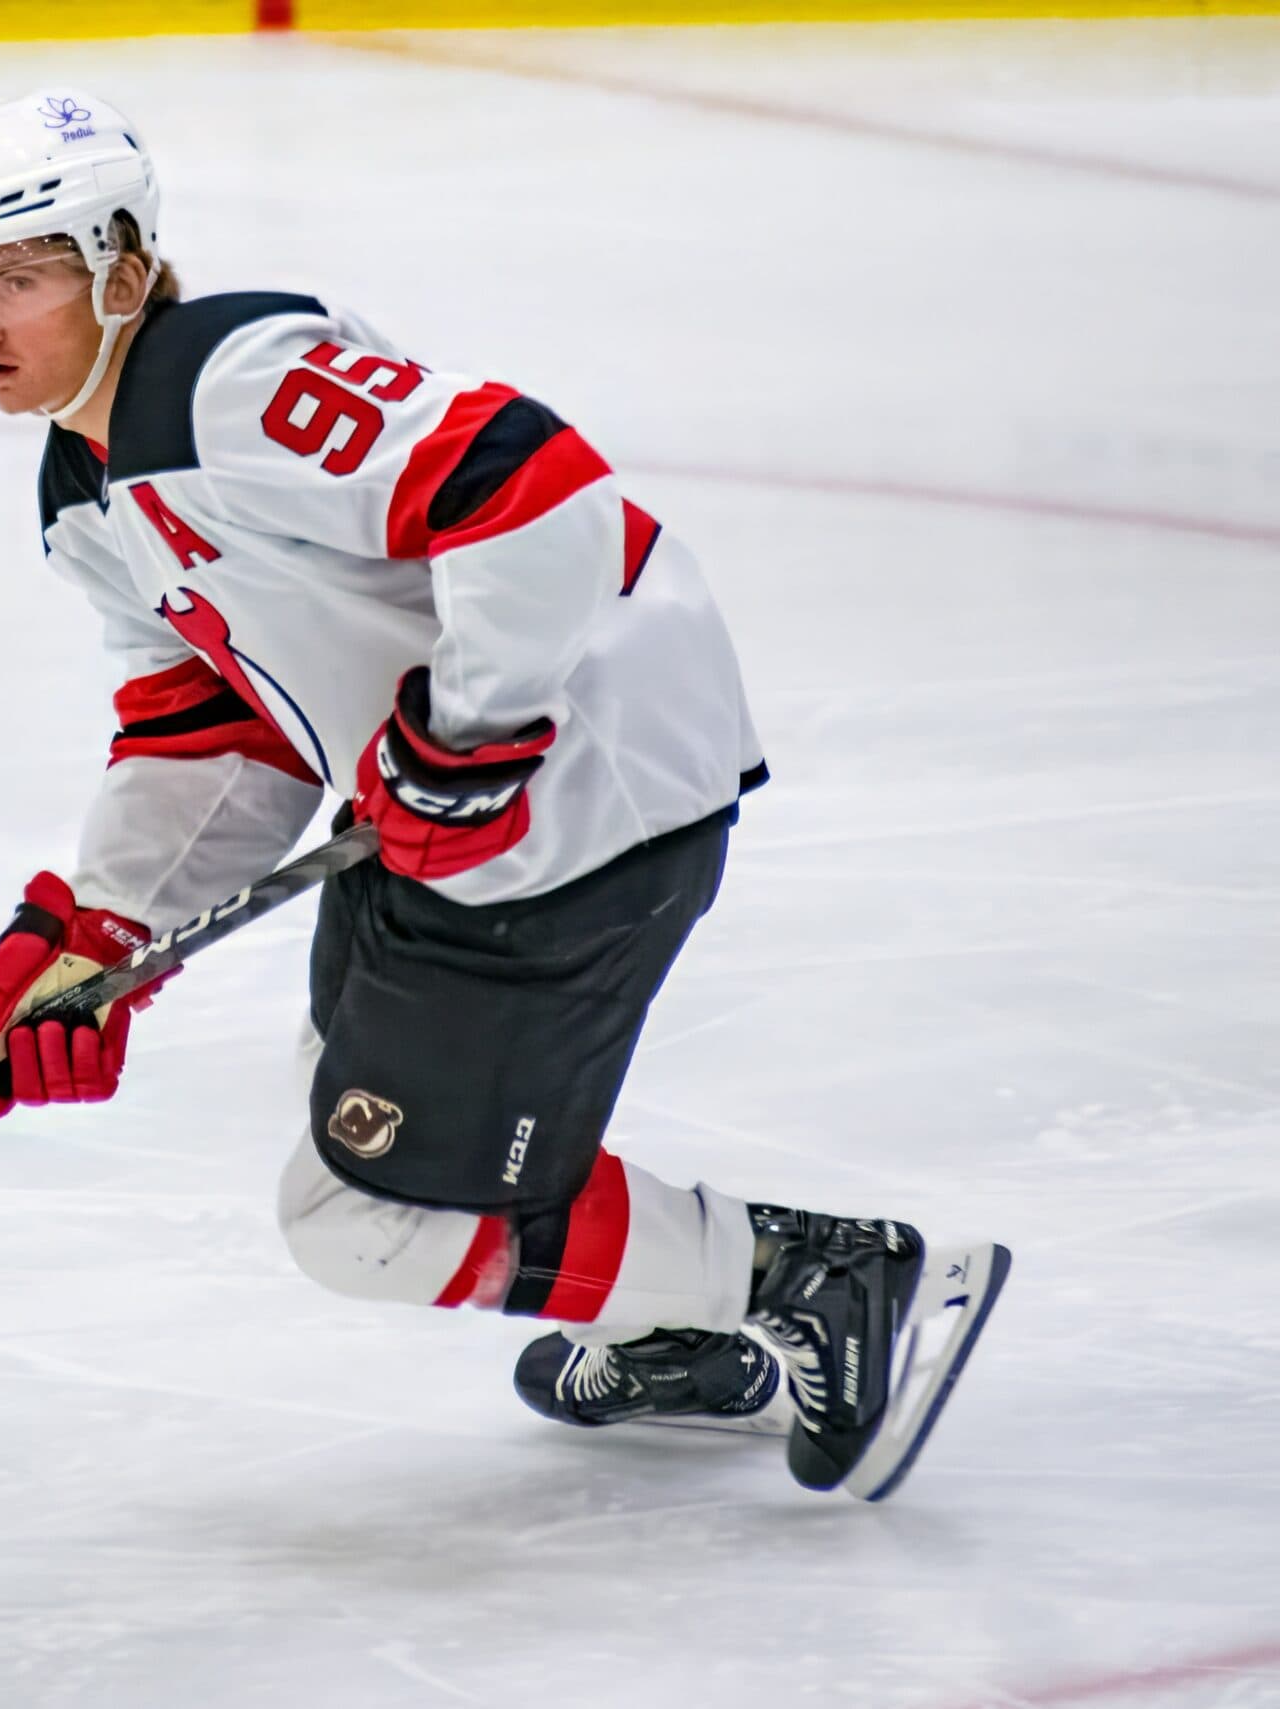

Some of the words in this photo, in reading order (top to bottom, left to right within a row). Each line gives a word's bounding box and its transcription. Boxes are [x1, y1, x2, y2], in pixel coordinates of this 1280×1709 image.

[261, 341, 432, 476] 95
[128, 481, 222, 570] A
[376, 735, 521, 818] CCM
[131, 886, 252, 969] CCM
[502, 1117, 536, 1186] CCM
